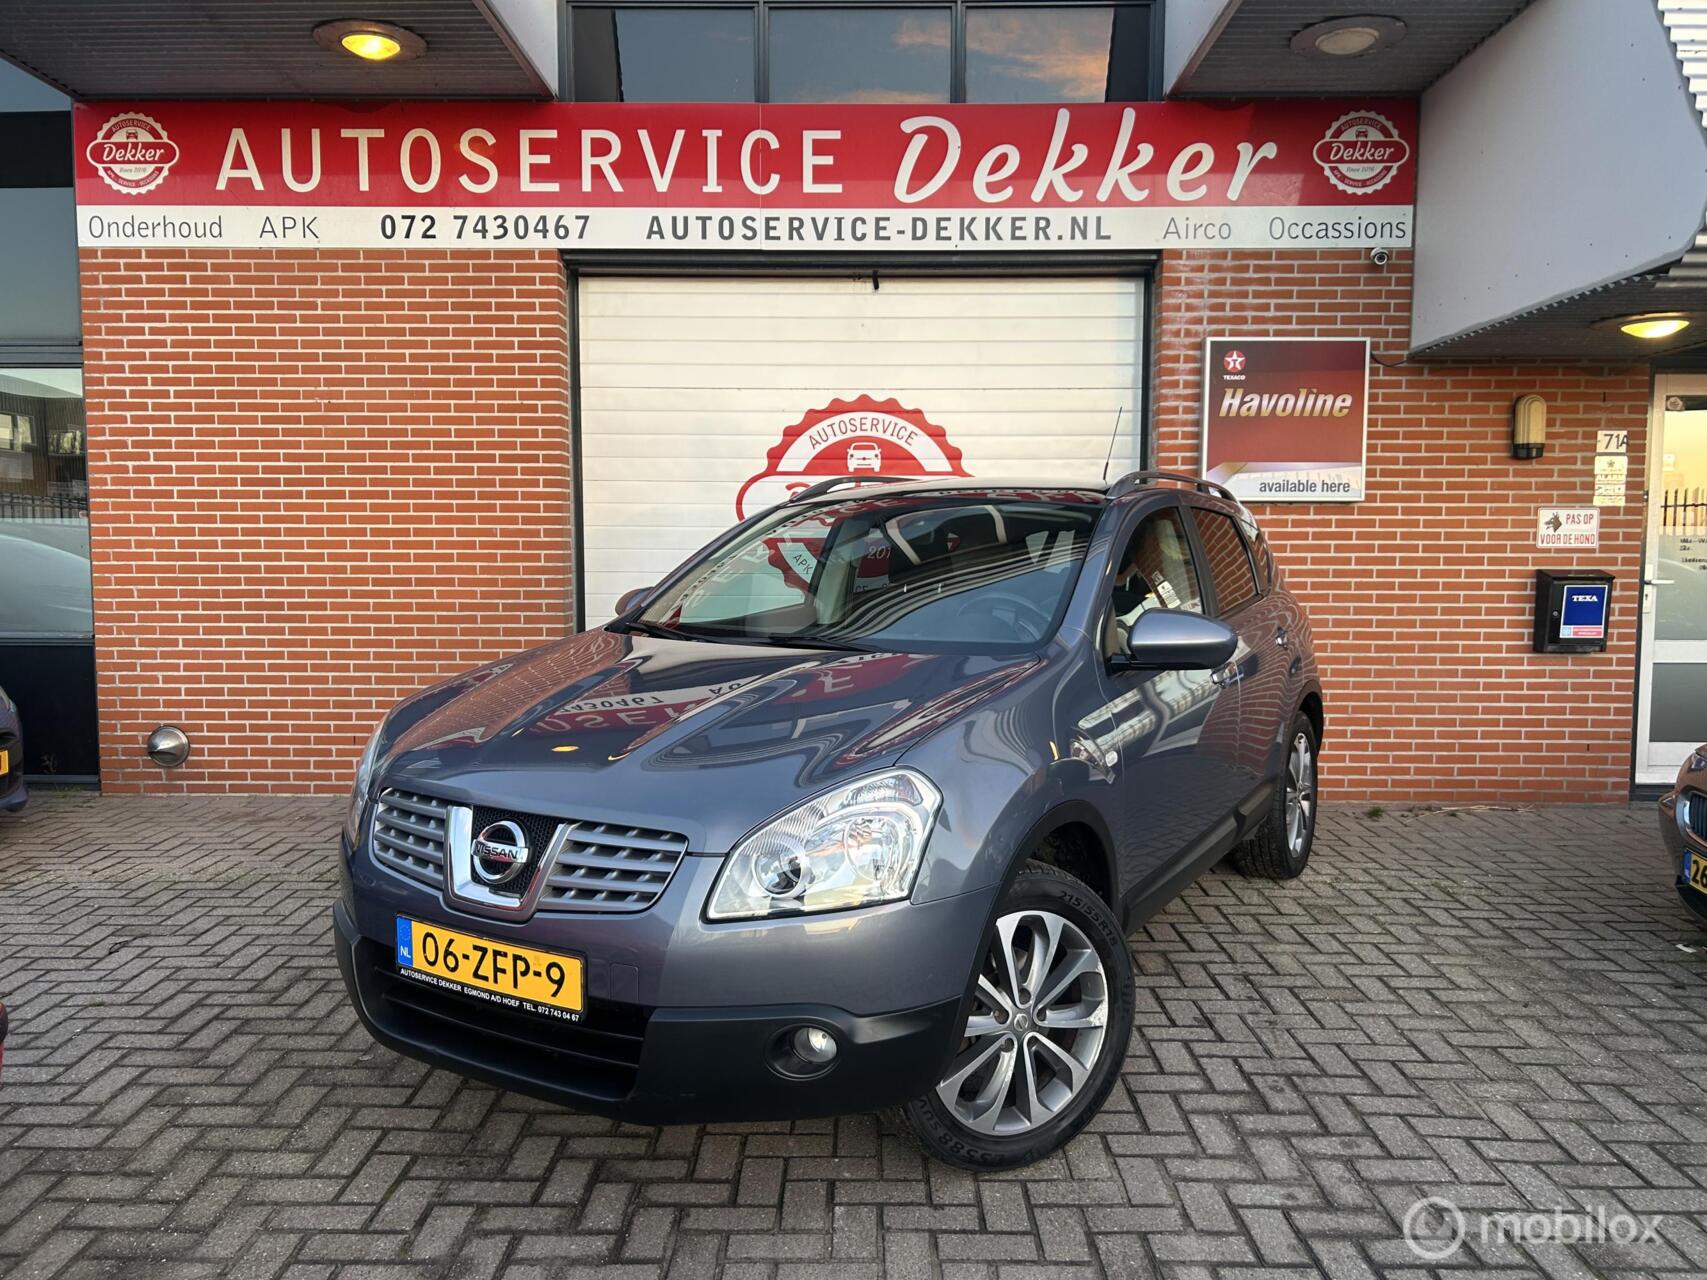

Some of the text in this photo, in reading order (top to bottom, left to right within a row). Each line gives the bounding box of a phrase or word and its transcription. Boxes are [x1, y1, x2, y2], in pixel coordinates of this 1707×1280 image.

[111, 119, 150, 132] AUTOSERVICE
[1341, 118, 1383, 131] AUTOSERVICE
[103, 142, 165, 161] Dekker
[215, 107, 1278, 204] AUTOSERVICE Dekker
[1330, 141, 1394, 160] Dekker
[88, 214, 1407, 241] Onderhoud APK 072 7430467 AUTOSERVICE-DEKKER.NL Airco Occassions
[1219, 387, 1353, 418] Havoline
[808, 416, 919, 450] AUTOSERVICE
[1603, 433, 1629, 450] 71A
[1259, 479, 1350, 493] available here
[1565, 513, 1594, 525] PAS OP
[1540, 533, 1596, 545] VOOR DE HOND
[792, 553, 814, 575] APK
[475, 840, 518, 860] NISSAN
[400, 945, 411, 958] NL
[421, 931, 566, 999] 06-ZFP-9
[400, 967, 580, 1022] AUTOSERVICE DEKKER EGMOND A/D HOEF TEL. 072 743 04 67
